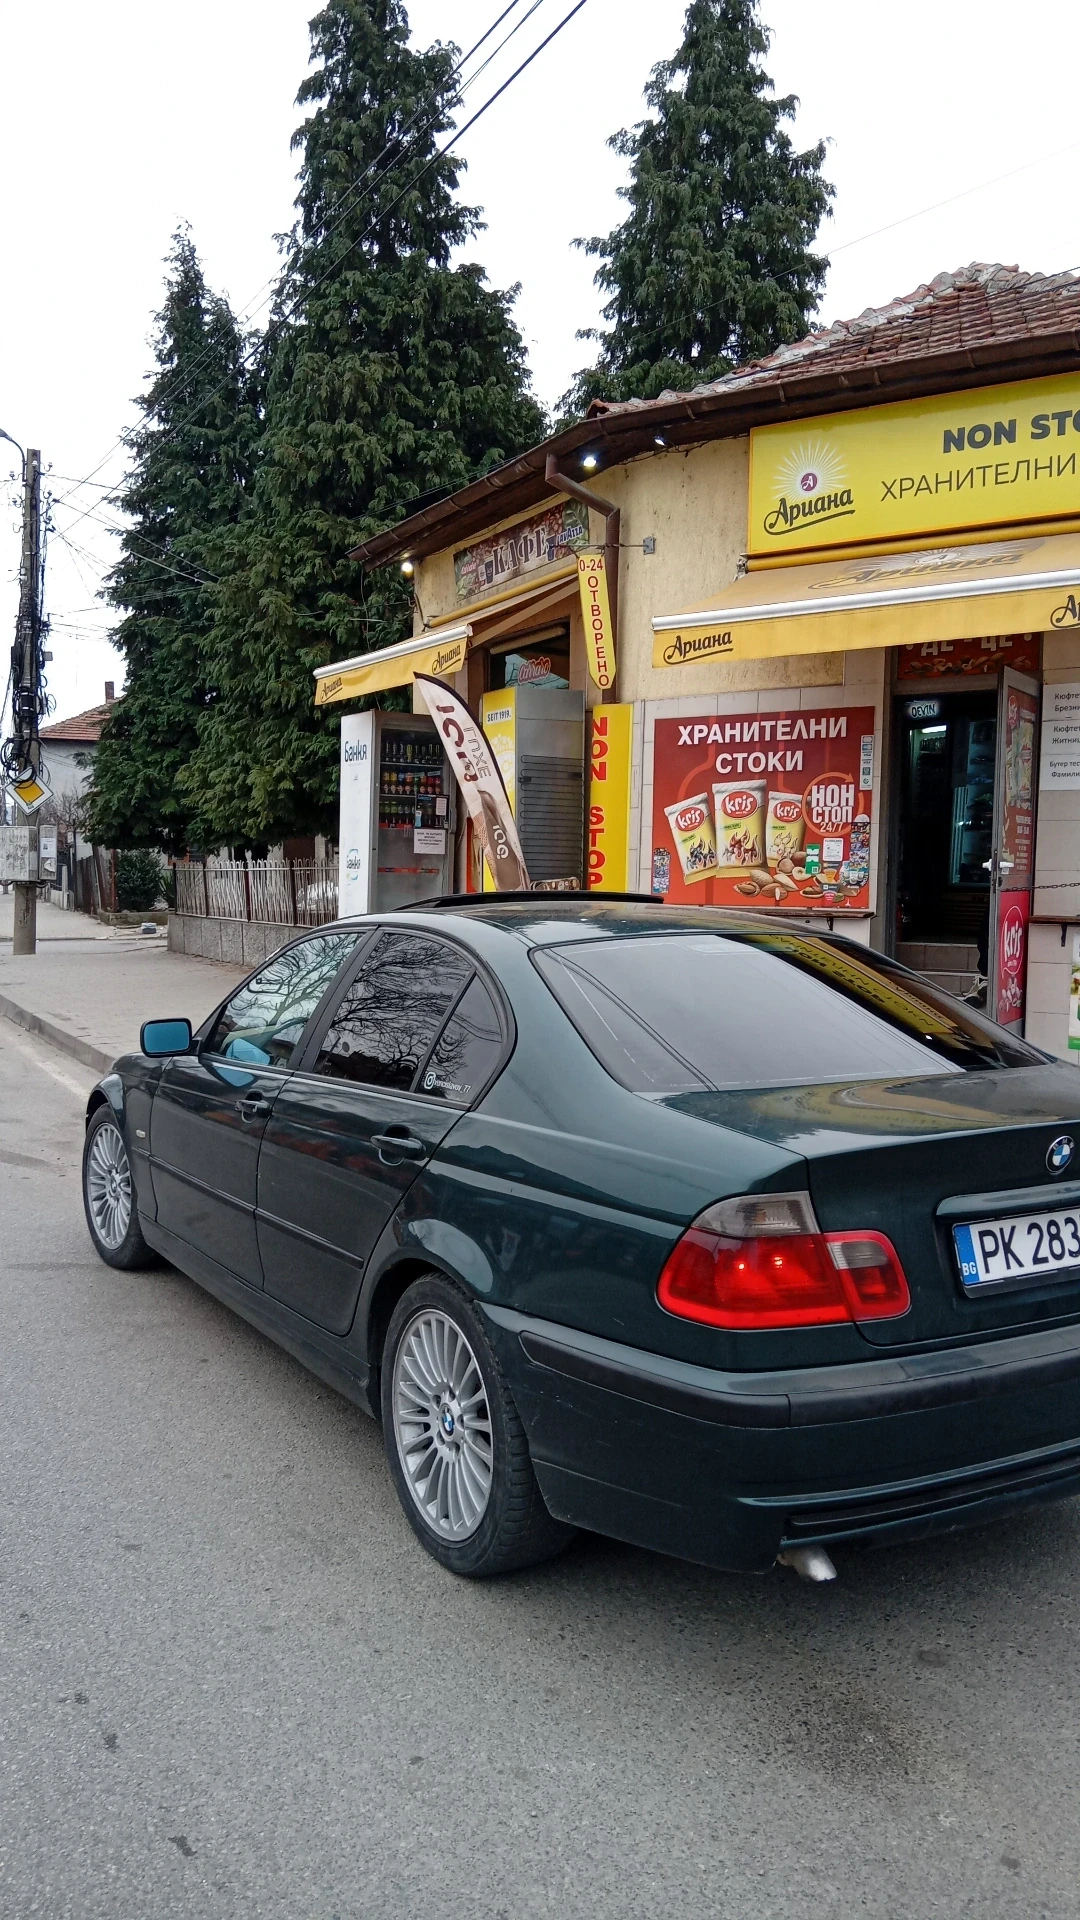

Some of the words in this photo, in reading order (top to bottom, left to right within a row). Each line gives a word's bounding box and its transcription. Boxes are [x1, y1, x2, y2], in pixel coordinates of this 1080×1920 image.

[943, 419, 1017, 454] NON
[880, 452, 1076, 502] ХРАНИТЕЛНИ
[763, 488, 855, 535] Ариана
[492, 527, 550, 576] КАФЕ
[579, 559, 603, 571] 0-24
[1050, 594, 1080, 628] А
[587, 575, 610, 687] ОТВОРЕНО
[431, 645, 461, 675] Ариана
[663, 632, 734, 665] Ариана
[1054, 692, 1080, 701] Кюфте
[487, 711, 499, 722] SEIT
[677, 716, 847, 746] ХРАНИТЕЛНИ
[591, 717, 609, 781] NON
[715, 750, 803, 774] СТОКИ
[677, 809, 701, 829] kris
[725, 795, 754, 814] kris
[777, 803, 800, 819] kris
[812, 806, 853, 823] СТОП
[820, 822, 843, 832] 24/7
[588, 806, 605, 890] STOP
[978, 1225, 1024, 1275] PK
[1027, 1216, 1080, 1265] 283
[962, 1262, 977, 1276] BG
